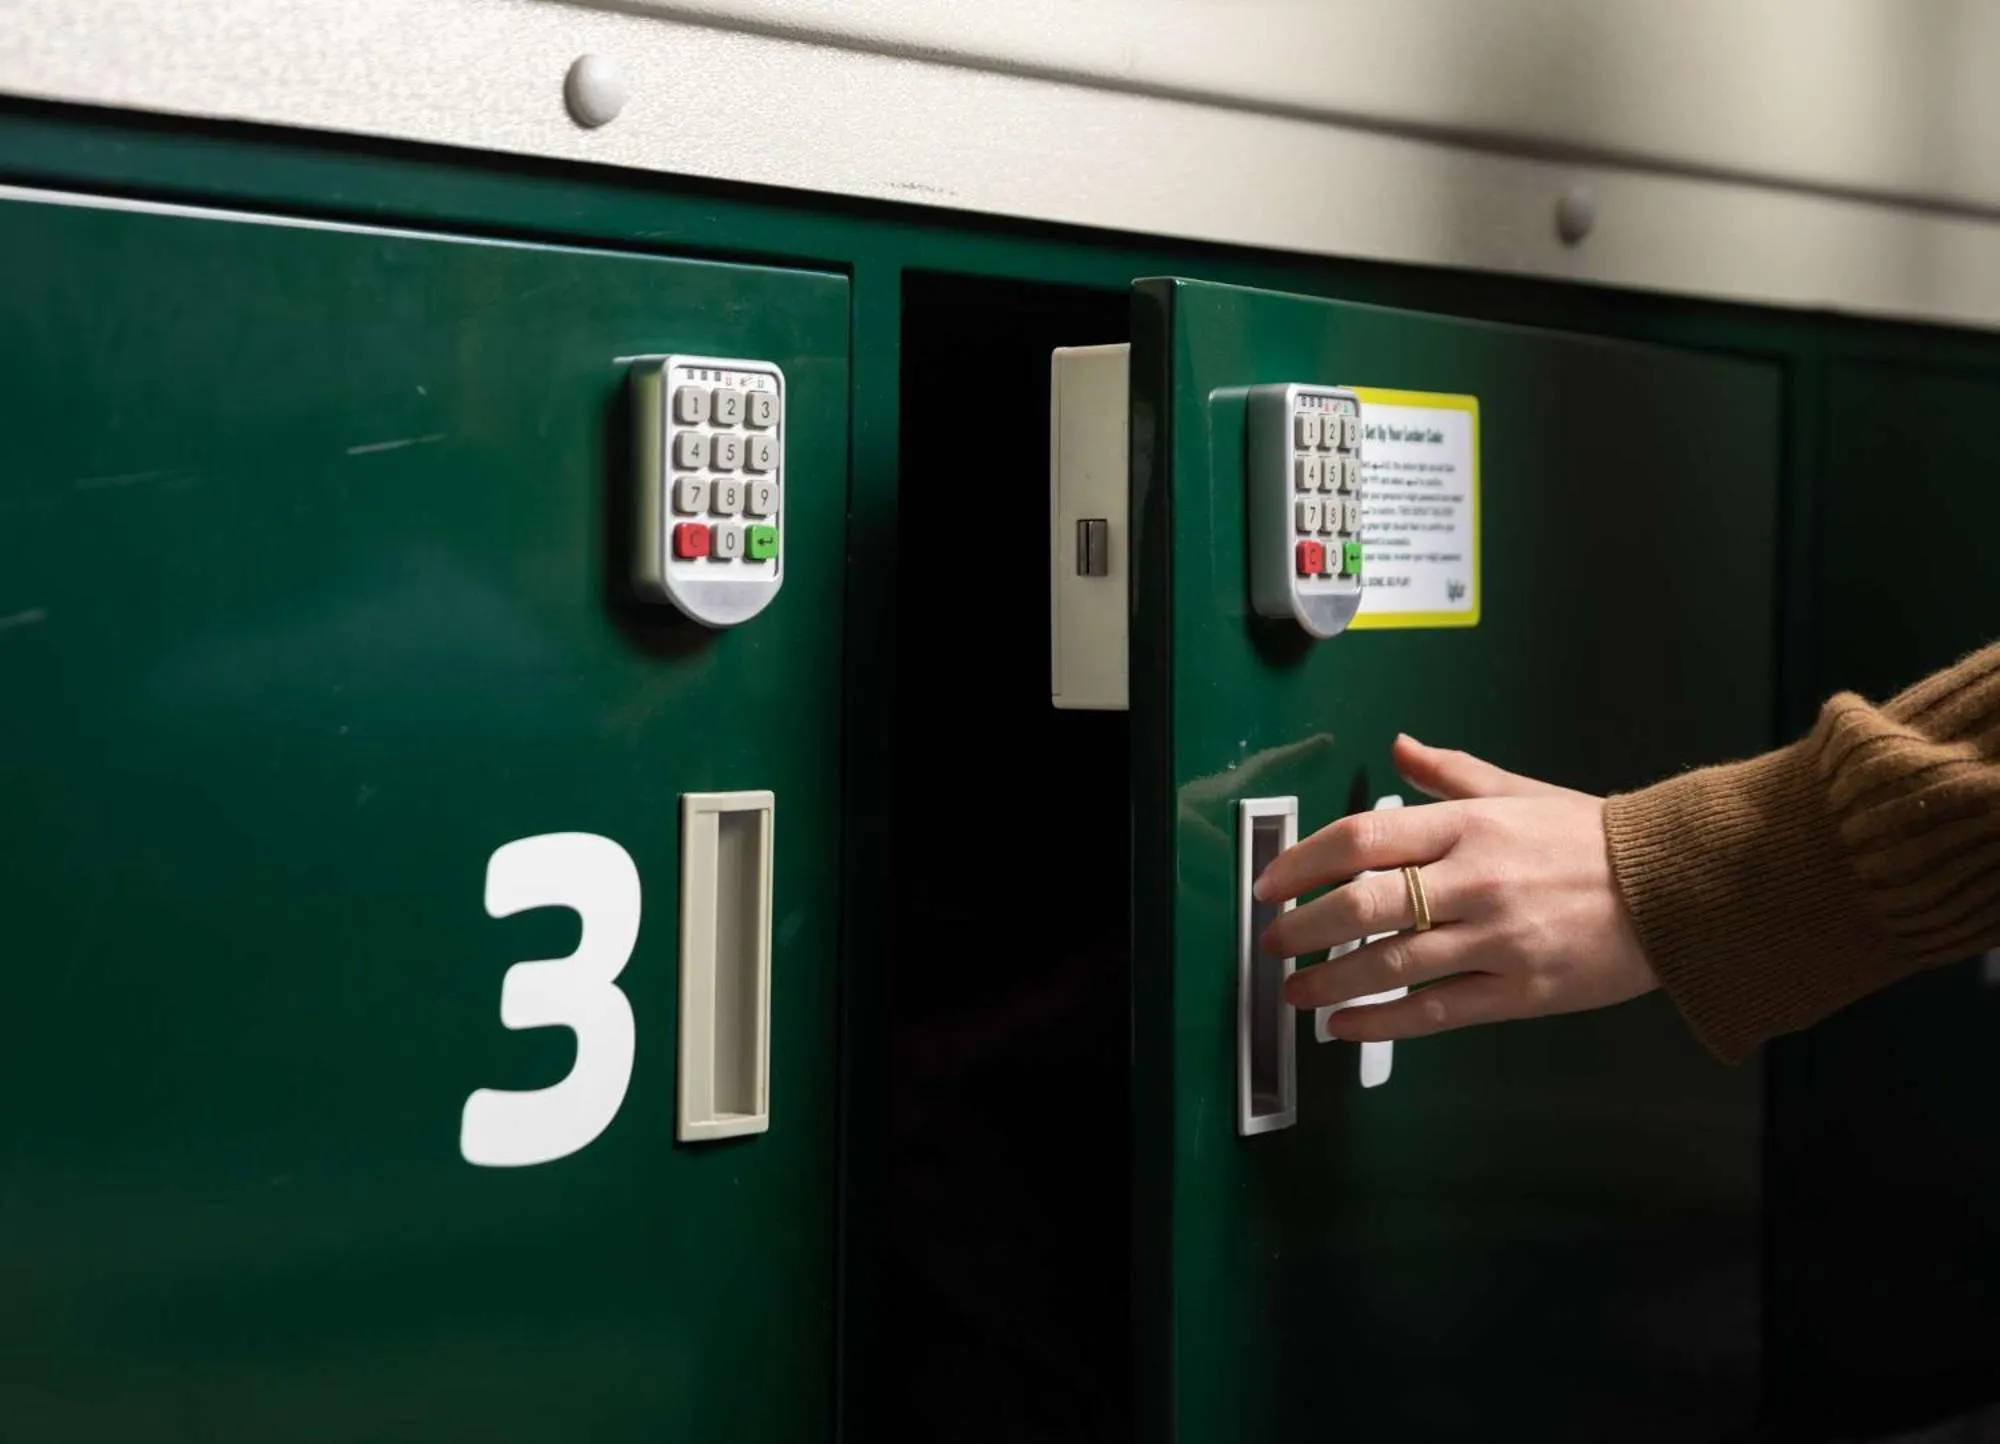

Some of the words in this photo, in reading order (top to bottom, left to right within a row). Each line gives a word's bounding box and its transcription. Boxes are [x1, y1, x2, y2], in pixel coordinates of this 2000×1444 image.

[692, 397, 699, 414] 1
[726, 399, 736, 416] 2
[761, 401, 770, 419] 3
[1329, 424, 1336, 440] 2
[691, 442, 700, 459] 4
[726, 444, 736, 461] 5
[761, 445, 769, 462] 6
[1309, 465, 1315, 480] 4
[1329, 465, 1336, 482] 5
[691, 486, 701, 504] 7
[726, 488, 736, 505] 8
[760, 489, 769, 506] 9
[1310, 508, 1316, 524] 7
[1330, 509, 1336, 524] 8
[690, 531, 700, 548] C
[726, 533, 735, 550] 0
[1310, 549, 1317, 564] C
[1330, 550, 1337, 566] 0
[460, 831, 641, 1167] 3
